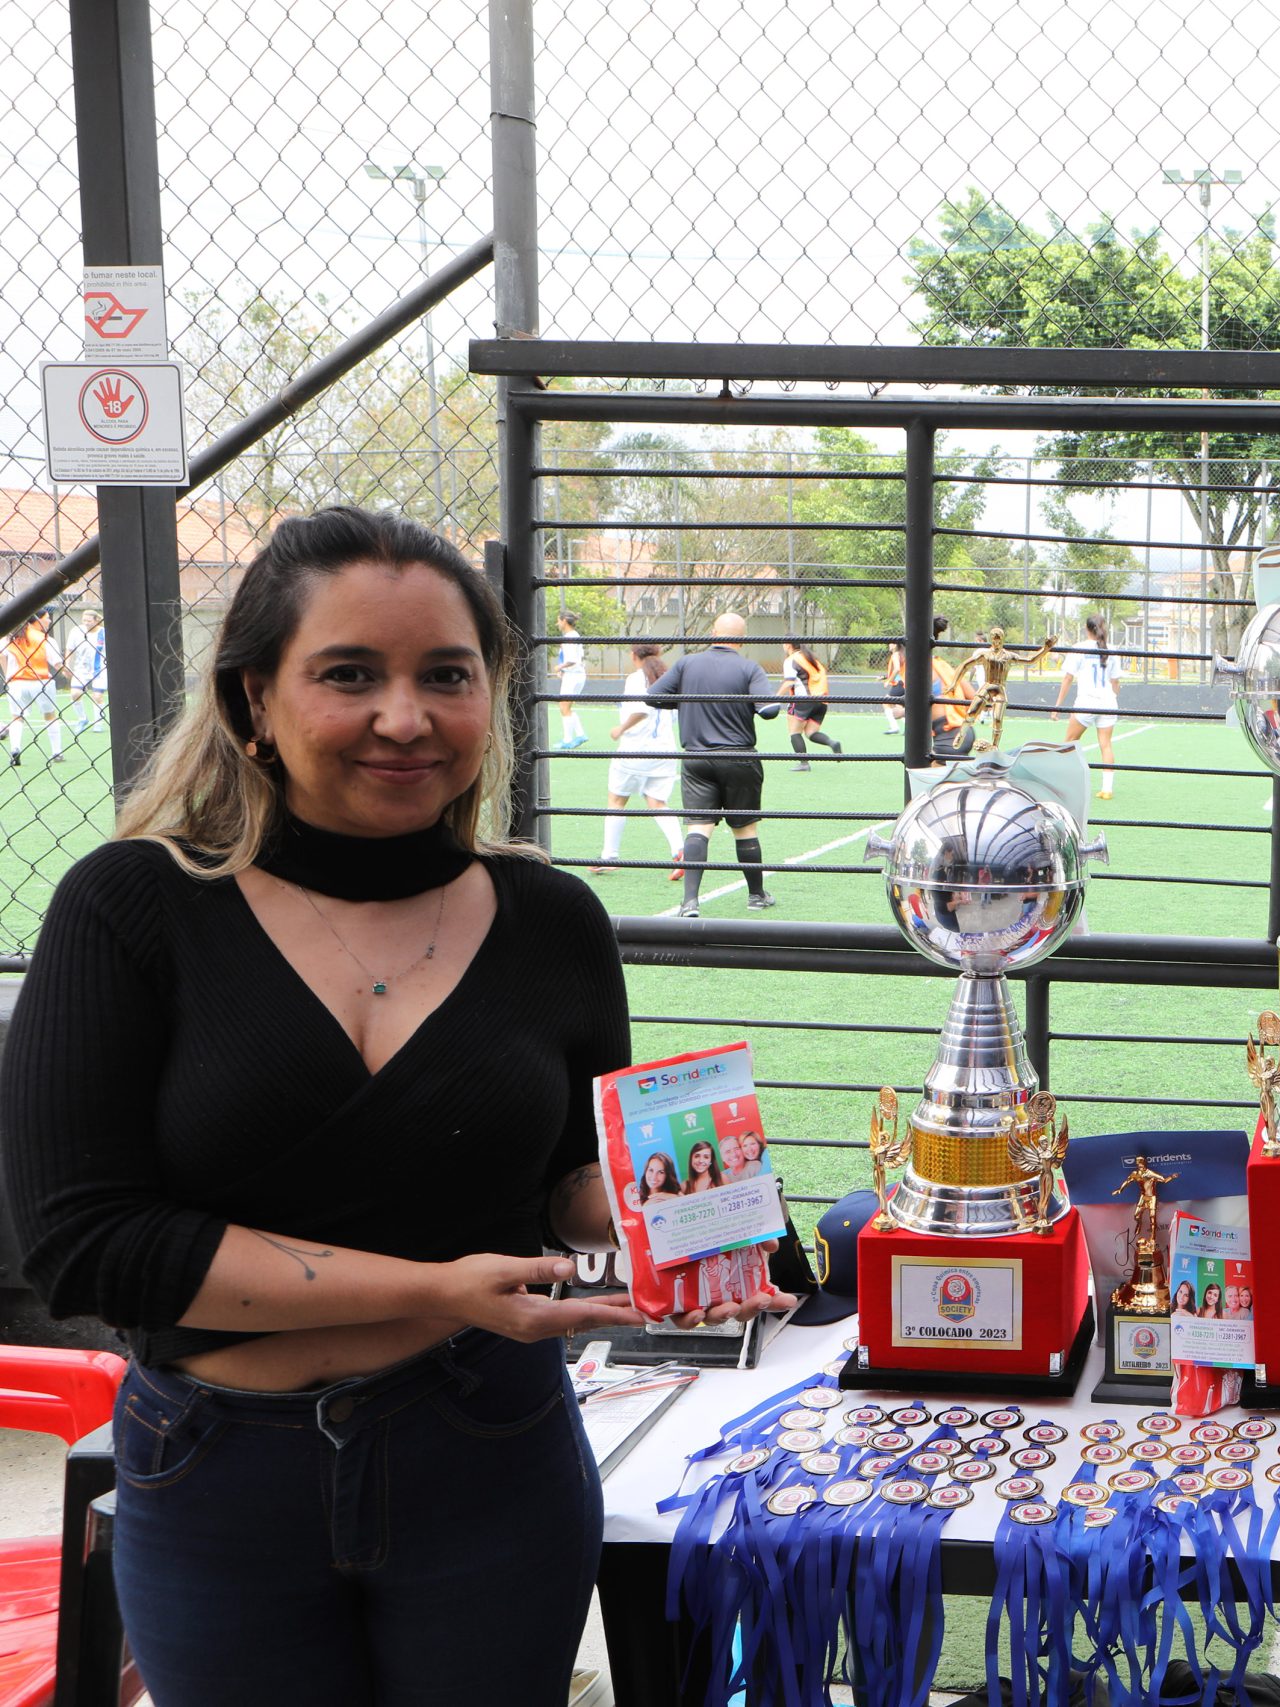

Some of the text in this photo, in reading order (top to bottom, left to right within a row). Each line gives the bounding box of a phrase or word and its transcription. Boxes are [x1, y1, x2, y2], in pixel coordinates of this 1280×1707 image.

[91, 271, 113, 279] fumar
[115, 271, 136, 279] neste
[137, 271, 158, 279] local.
[661, 1063, 728, 1086] Sorridents
[1146, 1153, 1192, 1163] orridents
[678, 1207, 716, 1224] 4338-7270
[727, 1195, 764, 1212] 2381-3967
[1201, 1226, 1239, 1240] Sorridents
[930, 1281, 939, 1296] Copa
[935, 1267, 958, 1281] Química
[958, 1268, 974, 1279] entre
[972, 1277, 981, 1304] empresas
[940, 1305, 973, 1314] SOCIETY
[905, 1325, 1007, 1339] 3º COLOCADO 2023
[1222, 1332, 1247, 1340] 2381-3967
[1121, 1360, 1152, 1368] ARTILHEIRO
